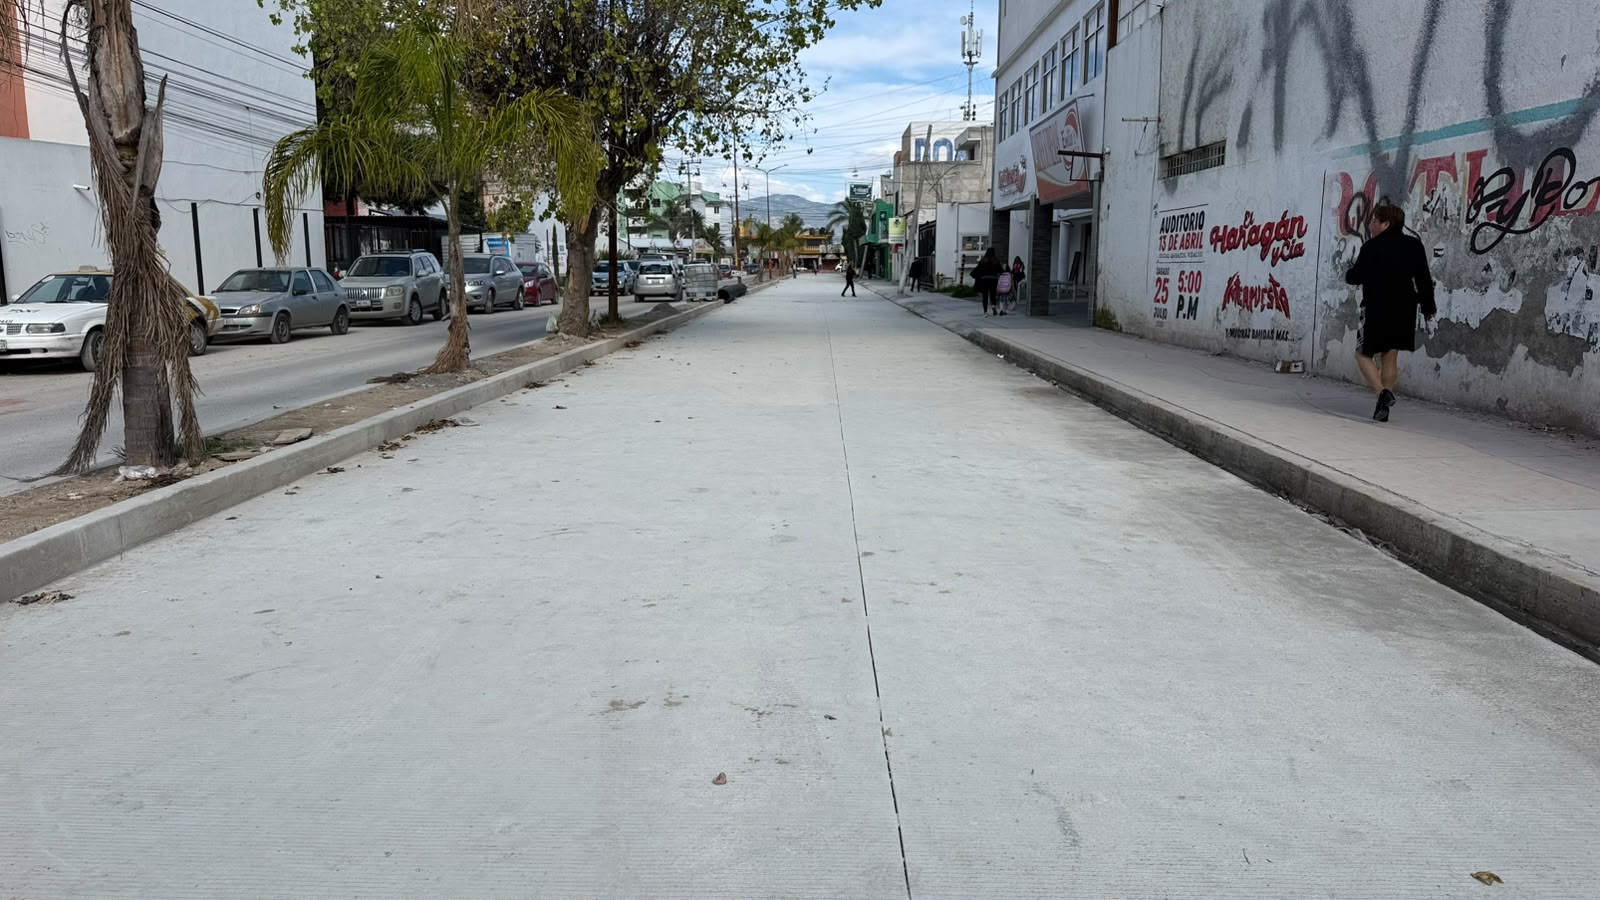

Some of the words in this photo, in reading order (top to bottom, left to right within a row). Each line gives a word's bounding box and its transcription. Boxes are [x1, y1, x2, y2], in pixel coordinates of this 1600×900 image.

[1159, 211, 1205, 234] AUDITORIO
[1168, 234, 1178, 251] DE
[1179, 231, 1204, 250] ABRIL
[1209, 210, 1308, 262] Haragán
[1154, 277, 1169, 304] 25
[1178, 270, 1202, 294] 5:00
[1176, 295, 1200, 320] P.M
